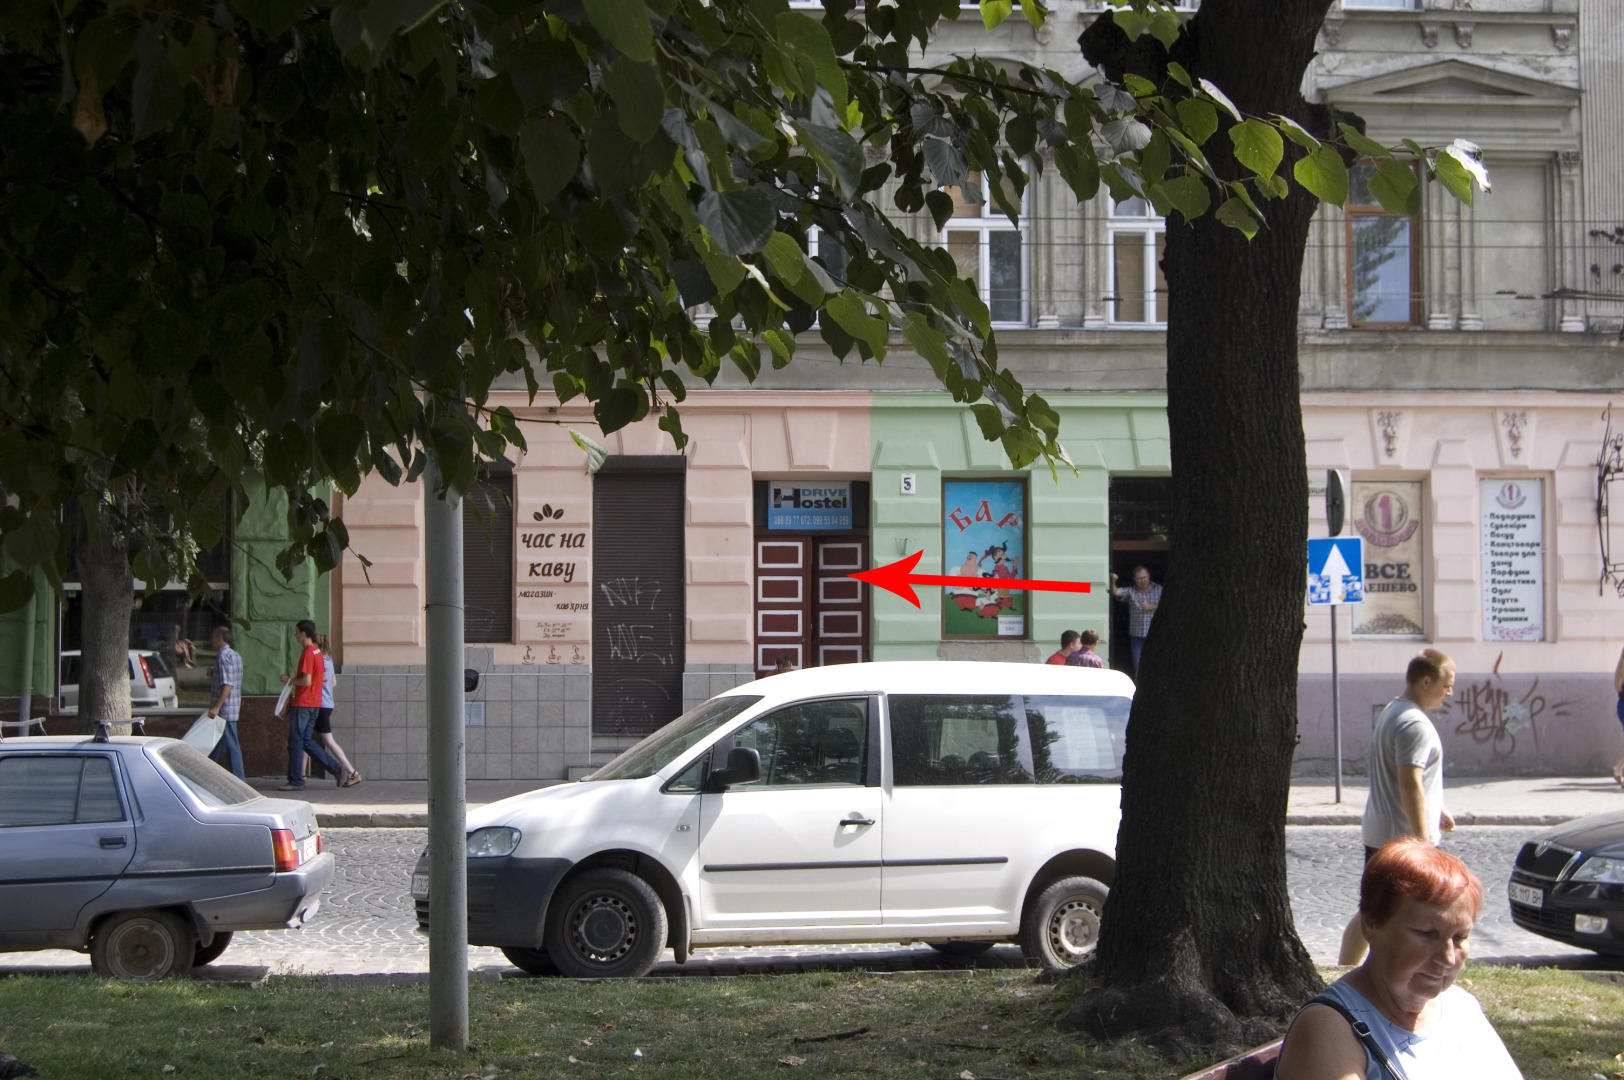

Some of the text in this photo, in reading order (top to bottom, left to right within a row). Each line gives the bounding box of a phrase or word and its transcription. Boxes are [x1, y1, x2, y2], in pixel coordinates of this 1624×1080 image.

[903, 477, 912, 491] 5
[774, 487, 848, 509] Hostel
[801, 488, 847, 497] DRIVE
[947, 500, 1019, 532] БАР
[1490, 513, 1536, 521] Подарунки
[1490, 531, 1515, 540] Посуд
[1365, 563, 1410, 579] ВСЕ
